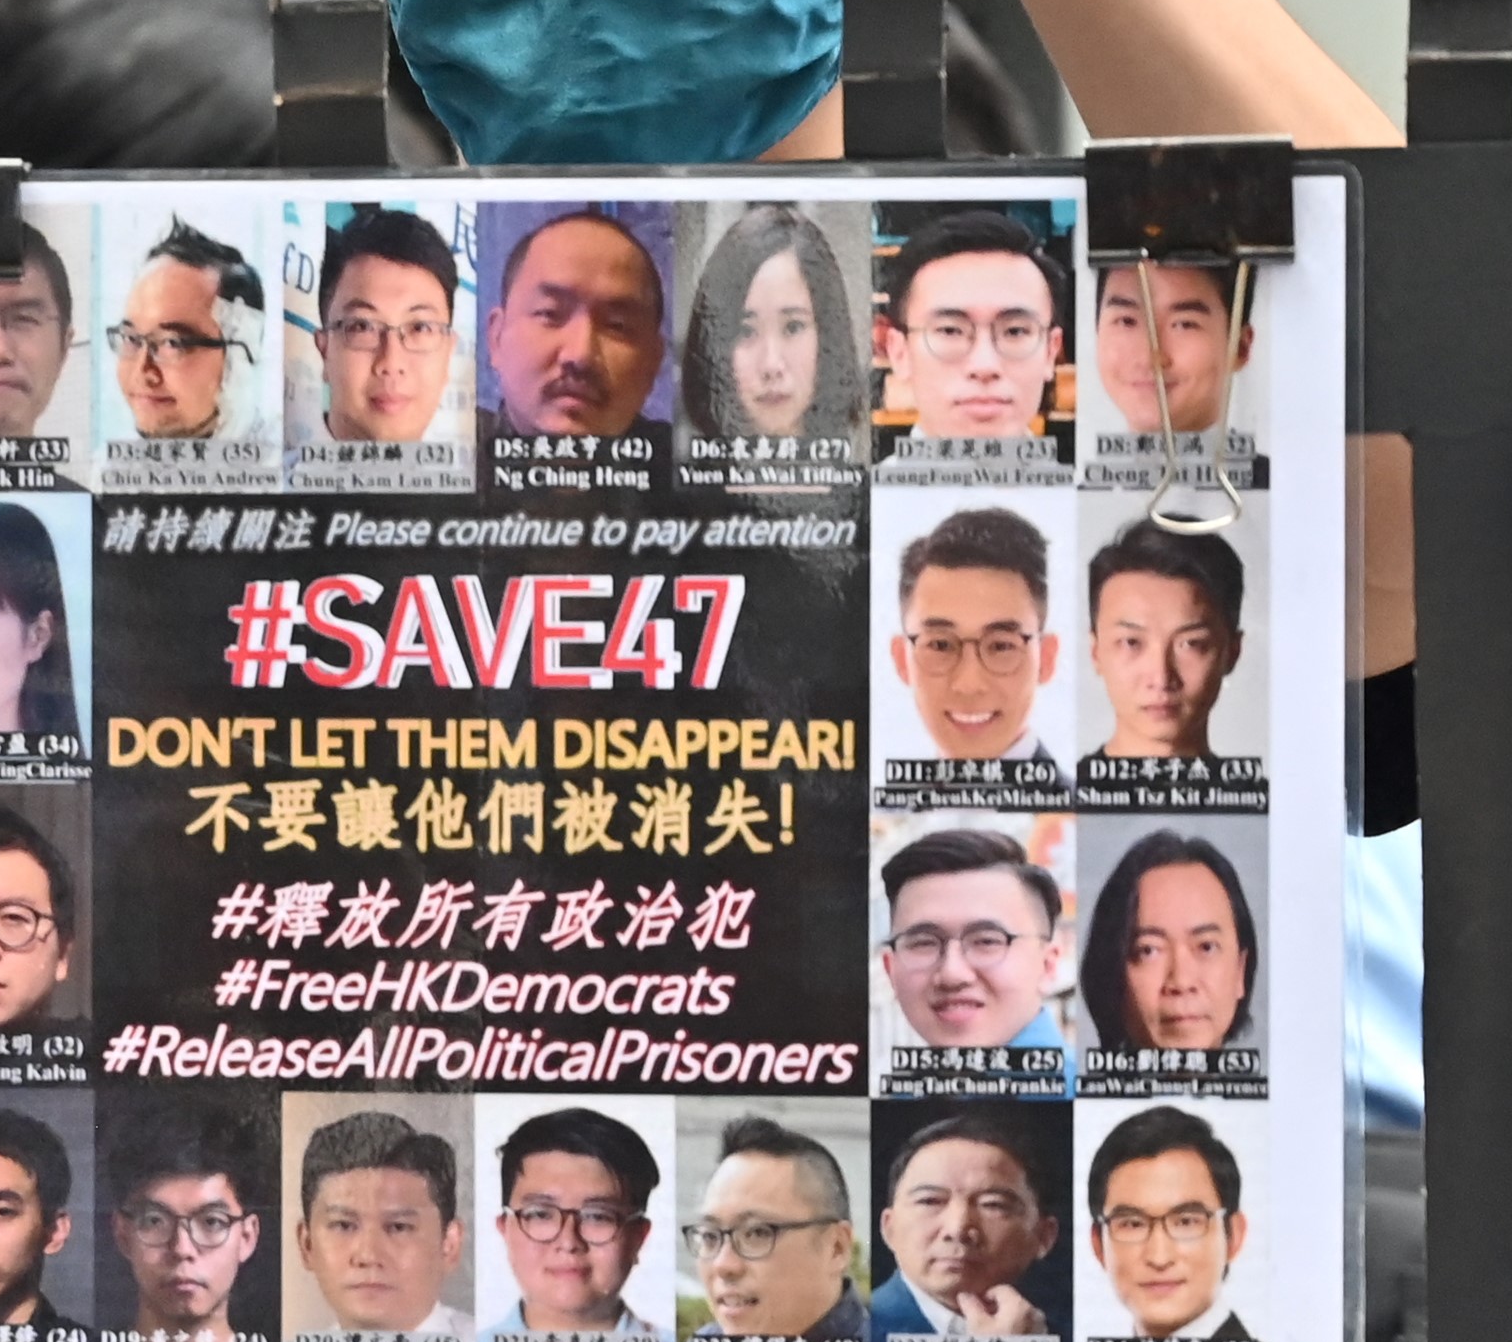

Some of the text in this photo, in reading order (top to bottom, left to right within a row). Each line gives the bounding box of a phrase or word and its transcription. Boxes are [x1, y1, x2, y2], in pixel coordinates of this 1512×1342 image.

[611, 437, 653, 462] (42)
[494, 465, 651, 492] Ng Ching Heng
[101, 507, 856, 556] 請持續關注 Please continue to pay attention
[222, 572, 747, 693] #SAVE47
[106, 716, 856, 771] DON'T LET THEM DISAPPEAR!
[183, 779, 796, 855] 不要讓他們被消失!
[211, 878, 758, 953] #釋放所有政治犯
[212, 959, 735, 1017] #FreeHKDemocrats
[25, 1062, 87, 1081] Kalvin
[42, 1035, 85, 1059] (32)
[101, 1023, 859, 1085] #ReleaseAllPoliticalPrisoners
